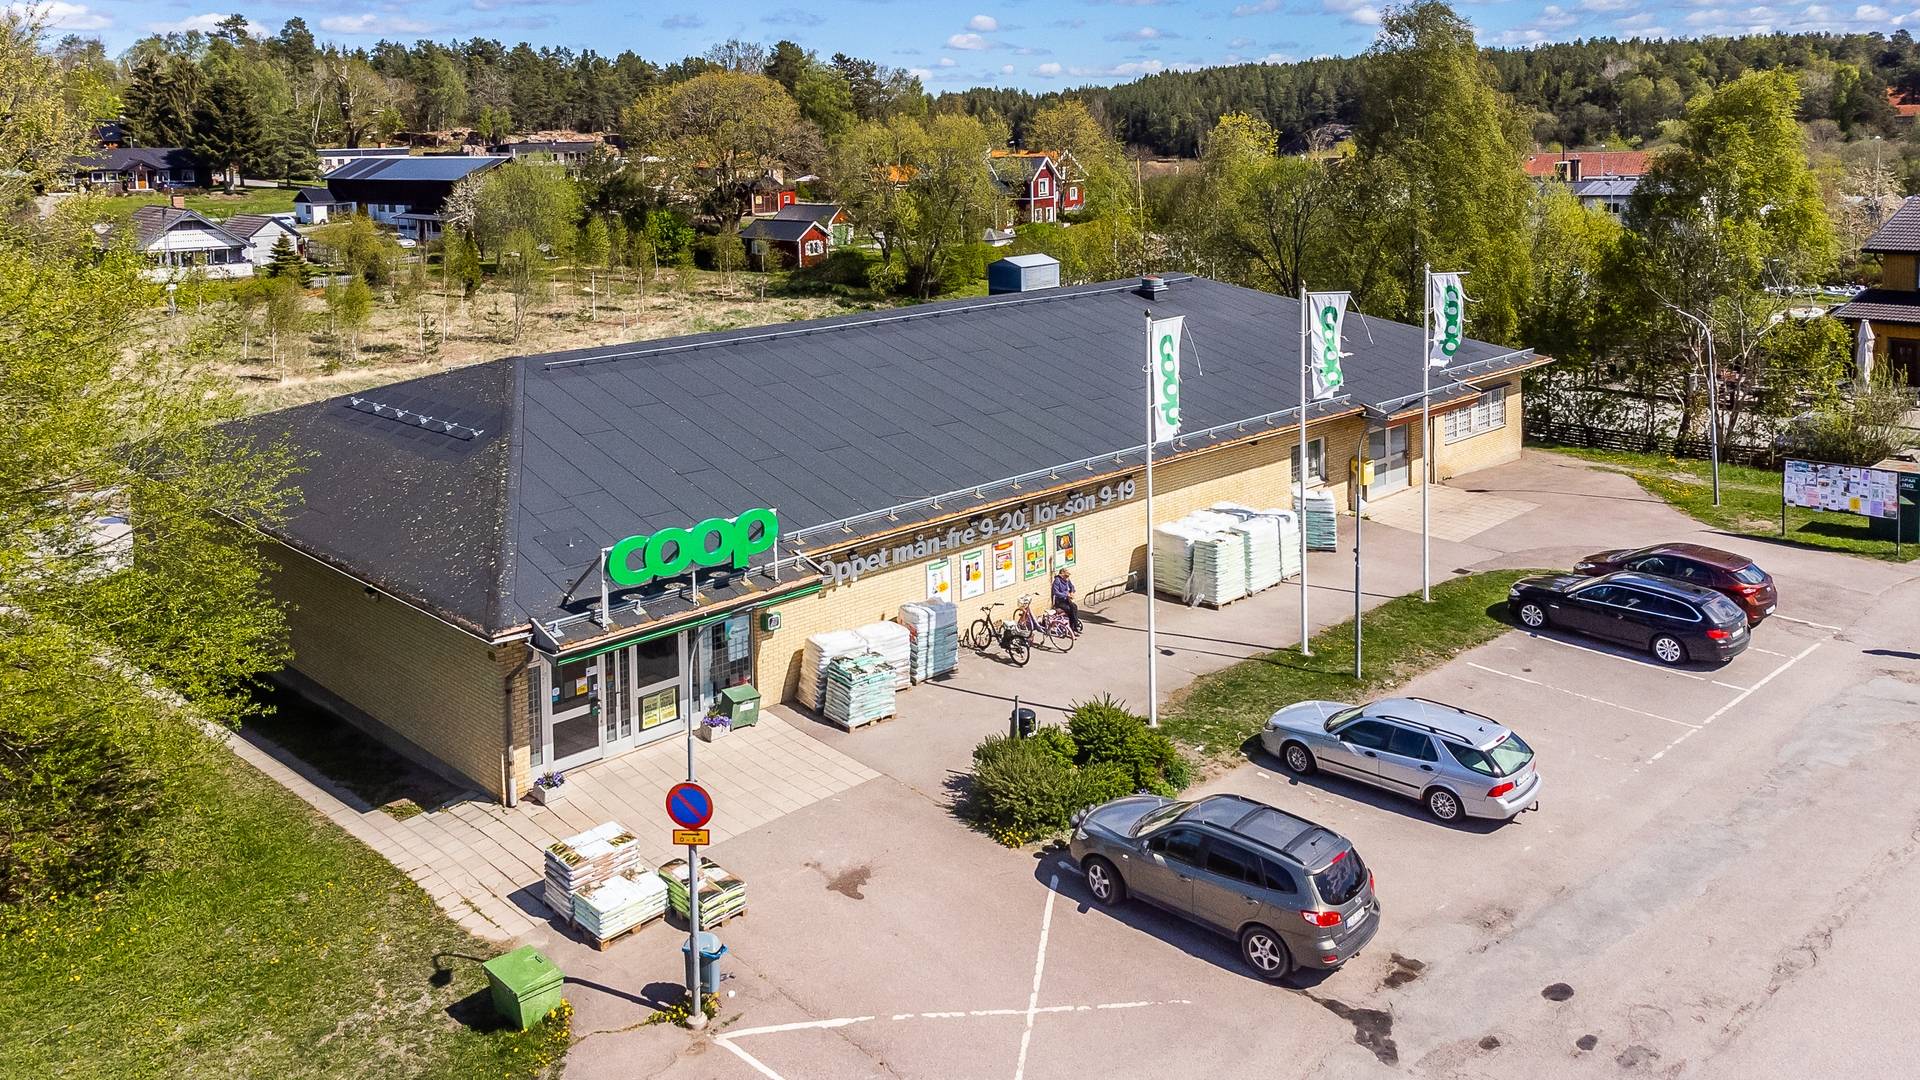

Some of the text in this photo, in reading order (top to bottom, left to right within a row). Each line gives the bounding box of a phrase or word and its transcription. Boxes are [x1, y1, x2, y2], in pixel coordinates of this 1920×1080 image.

[1320, 305, 1344, 387] coop
[1442, 285, 1460, 357] coop
[1159, 334, 1180, 426] coop
[608, 508, 780, 586] coop
[892, 527, 976, 563] mån-fre
[978, 510, 1031, 539] 9-20,
[1034, 492, 1096, 524] lör-sön
[1097, 479, 1136, 506] 9-19
